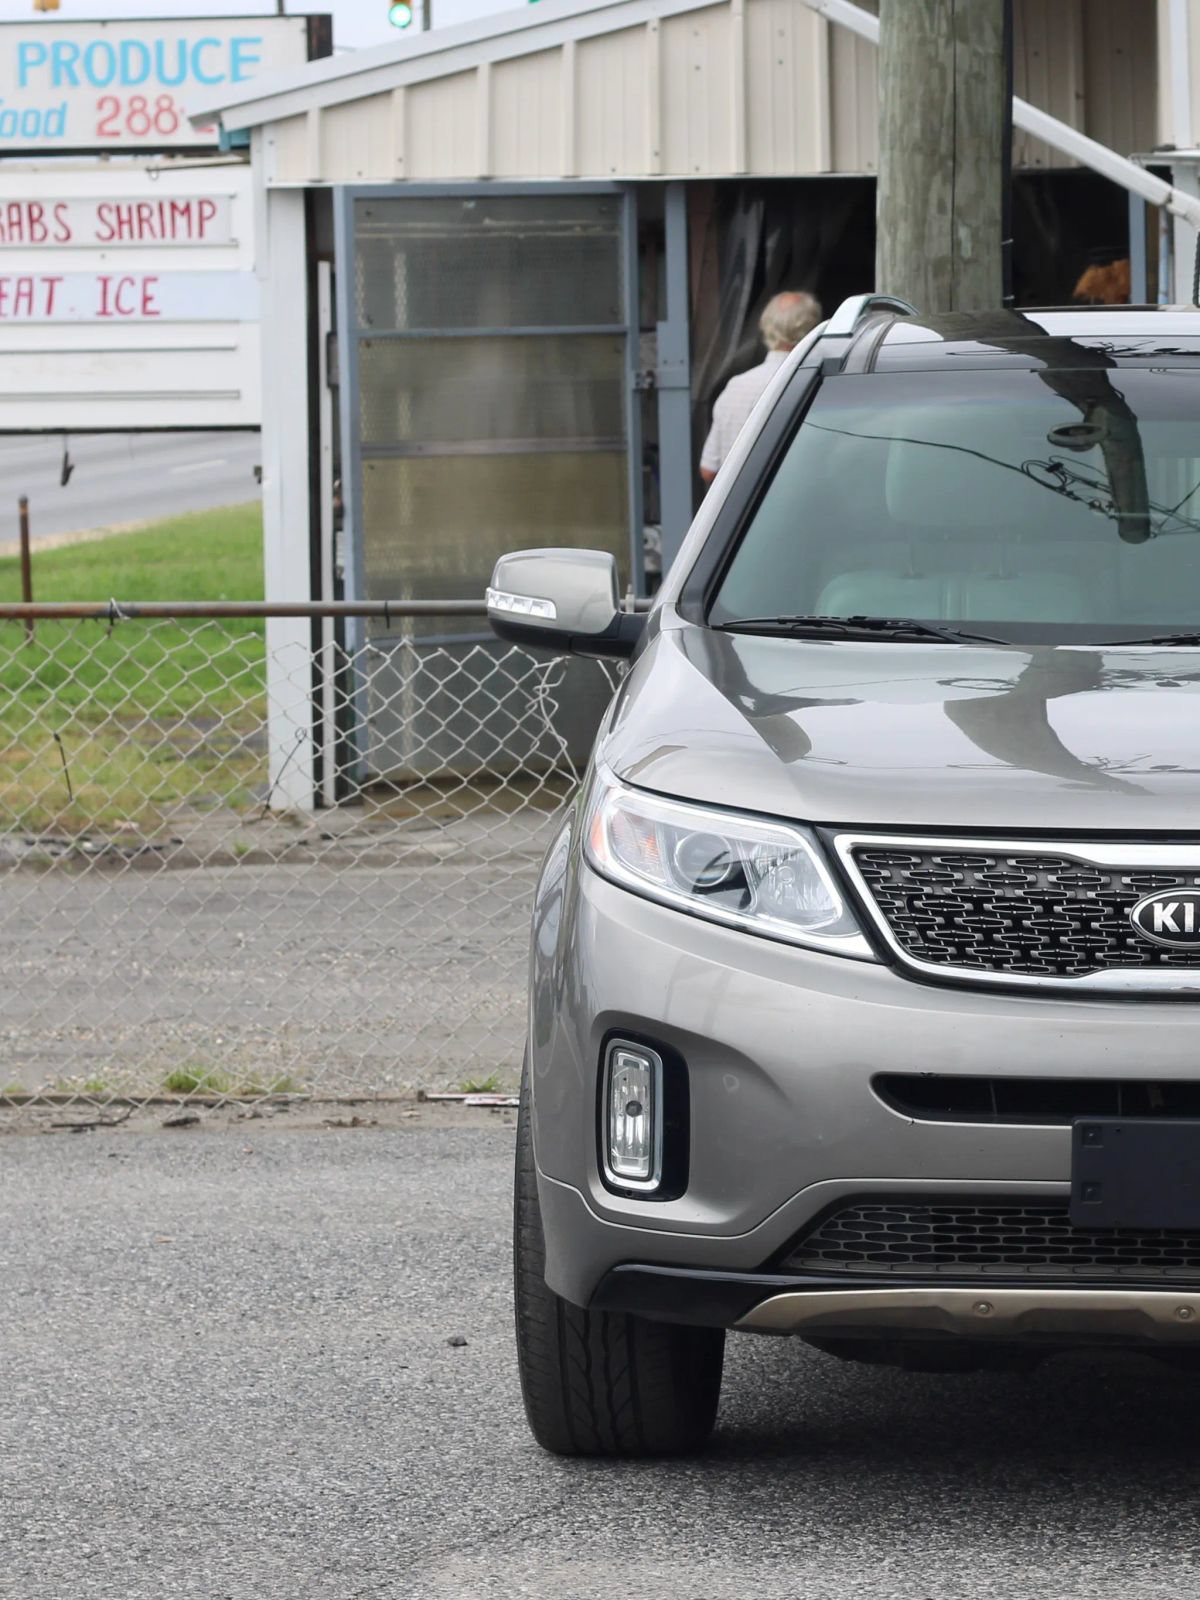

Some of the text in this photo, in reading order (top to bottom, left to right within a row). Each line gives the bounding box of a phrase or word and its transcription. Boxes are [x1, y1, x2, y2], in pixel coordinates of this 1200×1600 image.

[16, 36, 263, 88] PRODUCE
[0, 97, 67, 138] ood
[0, 198, 217, 242] ABS SHRIMP
[95, 276, 161, 316] ICE
